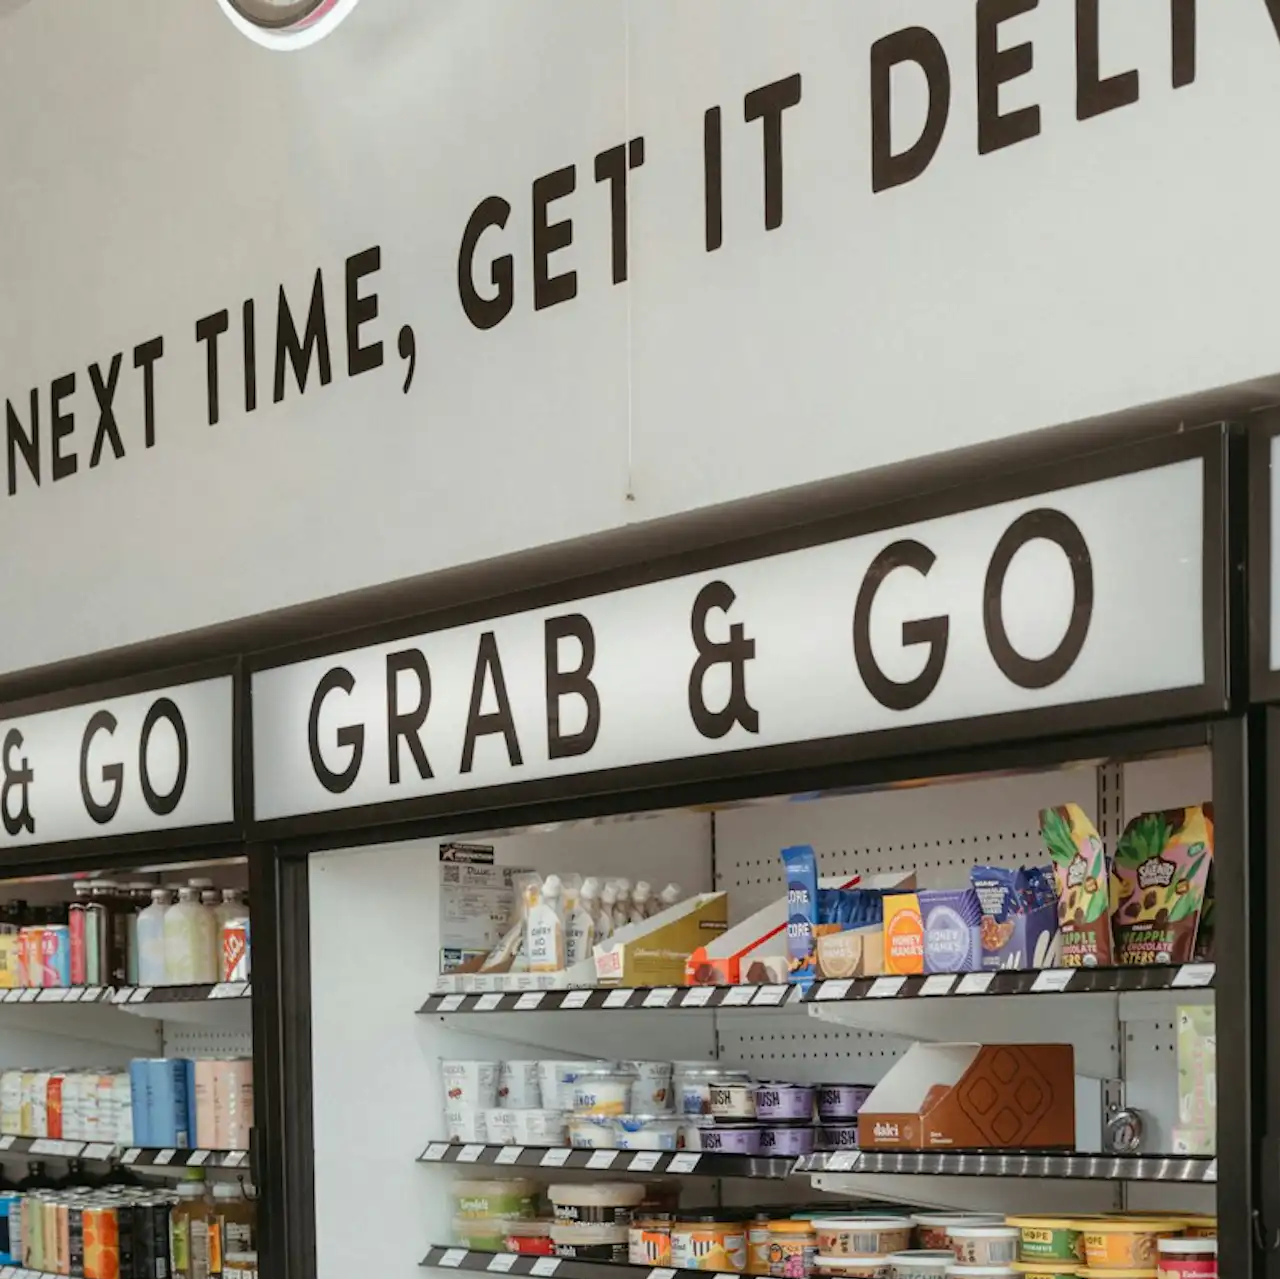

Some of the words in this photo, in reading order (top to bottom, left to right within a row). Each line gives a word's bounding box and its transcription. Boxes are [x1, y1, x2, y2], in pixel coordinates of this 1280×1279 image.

[6, 336, 163, 497] NEXT
[196, 245, 416, 394] TIME,
[458, 136, 645, 330] GET
[704, 73, 801, 252] IT
[308, 612, 600, 794] GRAB
[688, 580, 760, 740] &
[853, 507, 1094, 711] GO
[2, 727, 35, 836] &
[79, 697, 189, 824] GO
[1024, 1229, 1048, 1241] HOPE
